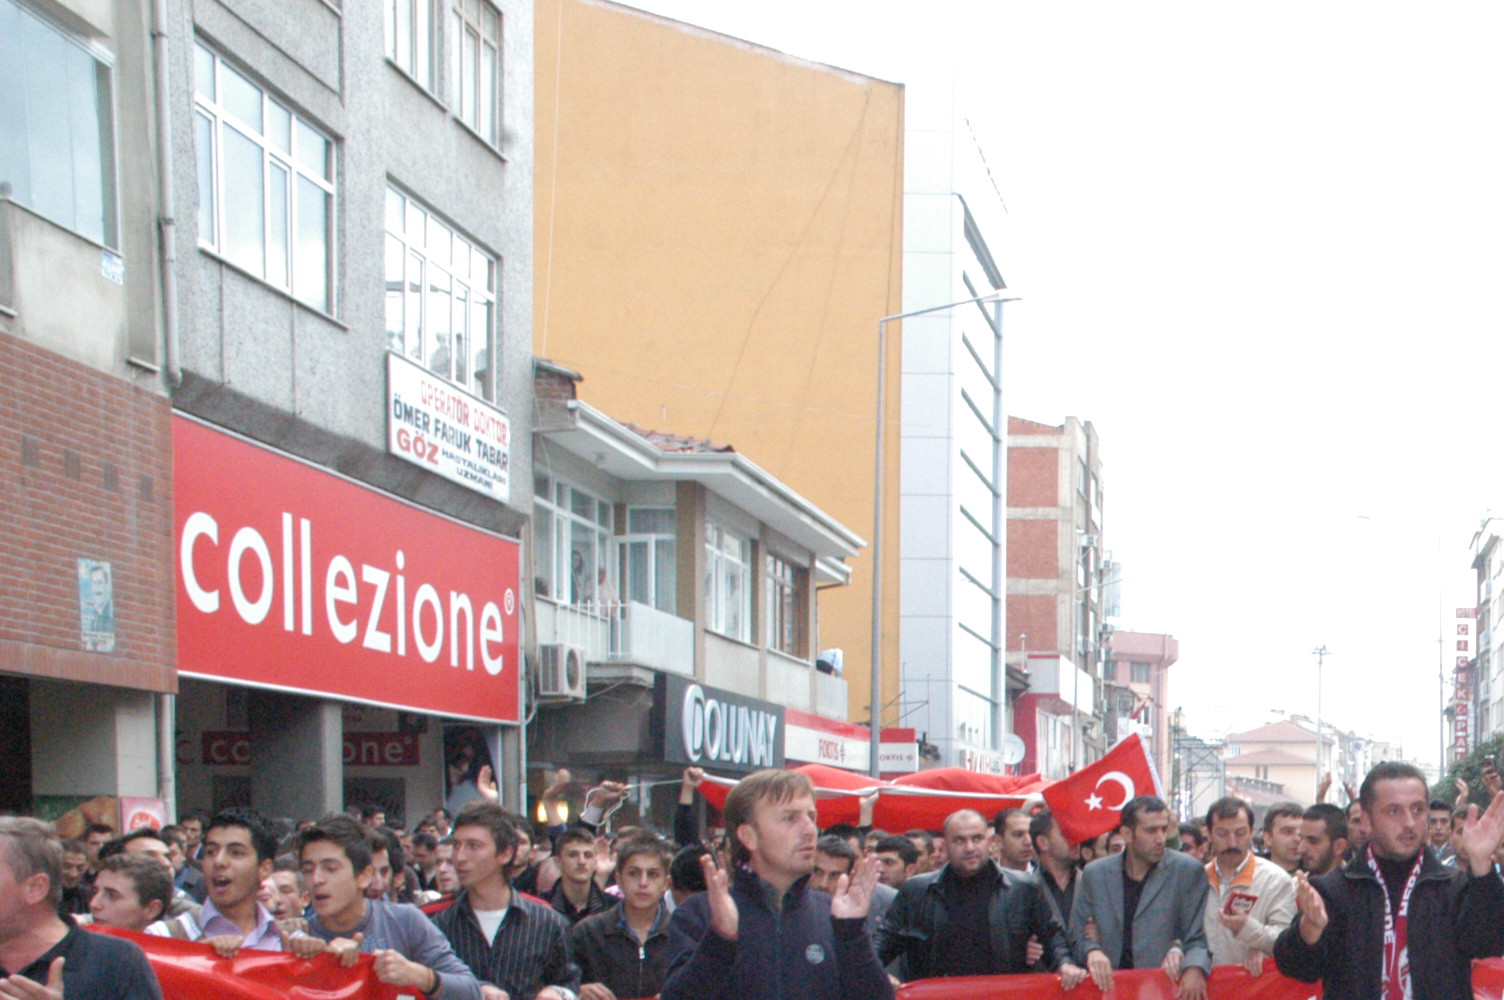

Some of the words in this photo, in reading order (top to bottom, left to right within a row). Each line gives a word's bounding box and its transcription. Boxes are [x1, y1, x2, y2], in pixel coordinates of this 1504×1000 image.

[393, 392, 430, 434] ÖMER
[434, 418, 471, 454] FARUK
[397, 427, 439, 466] GÖZ
[181, 511, 504, 676] collezione
[683, 684, 777, 767] DOLUNAY
[818, 738, 839, 761] FORTIS
[880, 753, 904, 761] ORTIS
